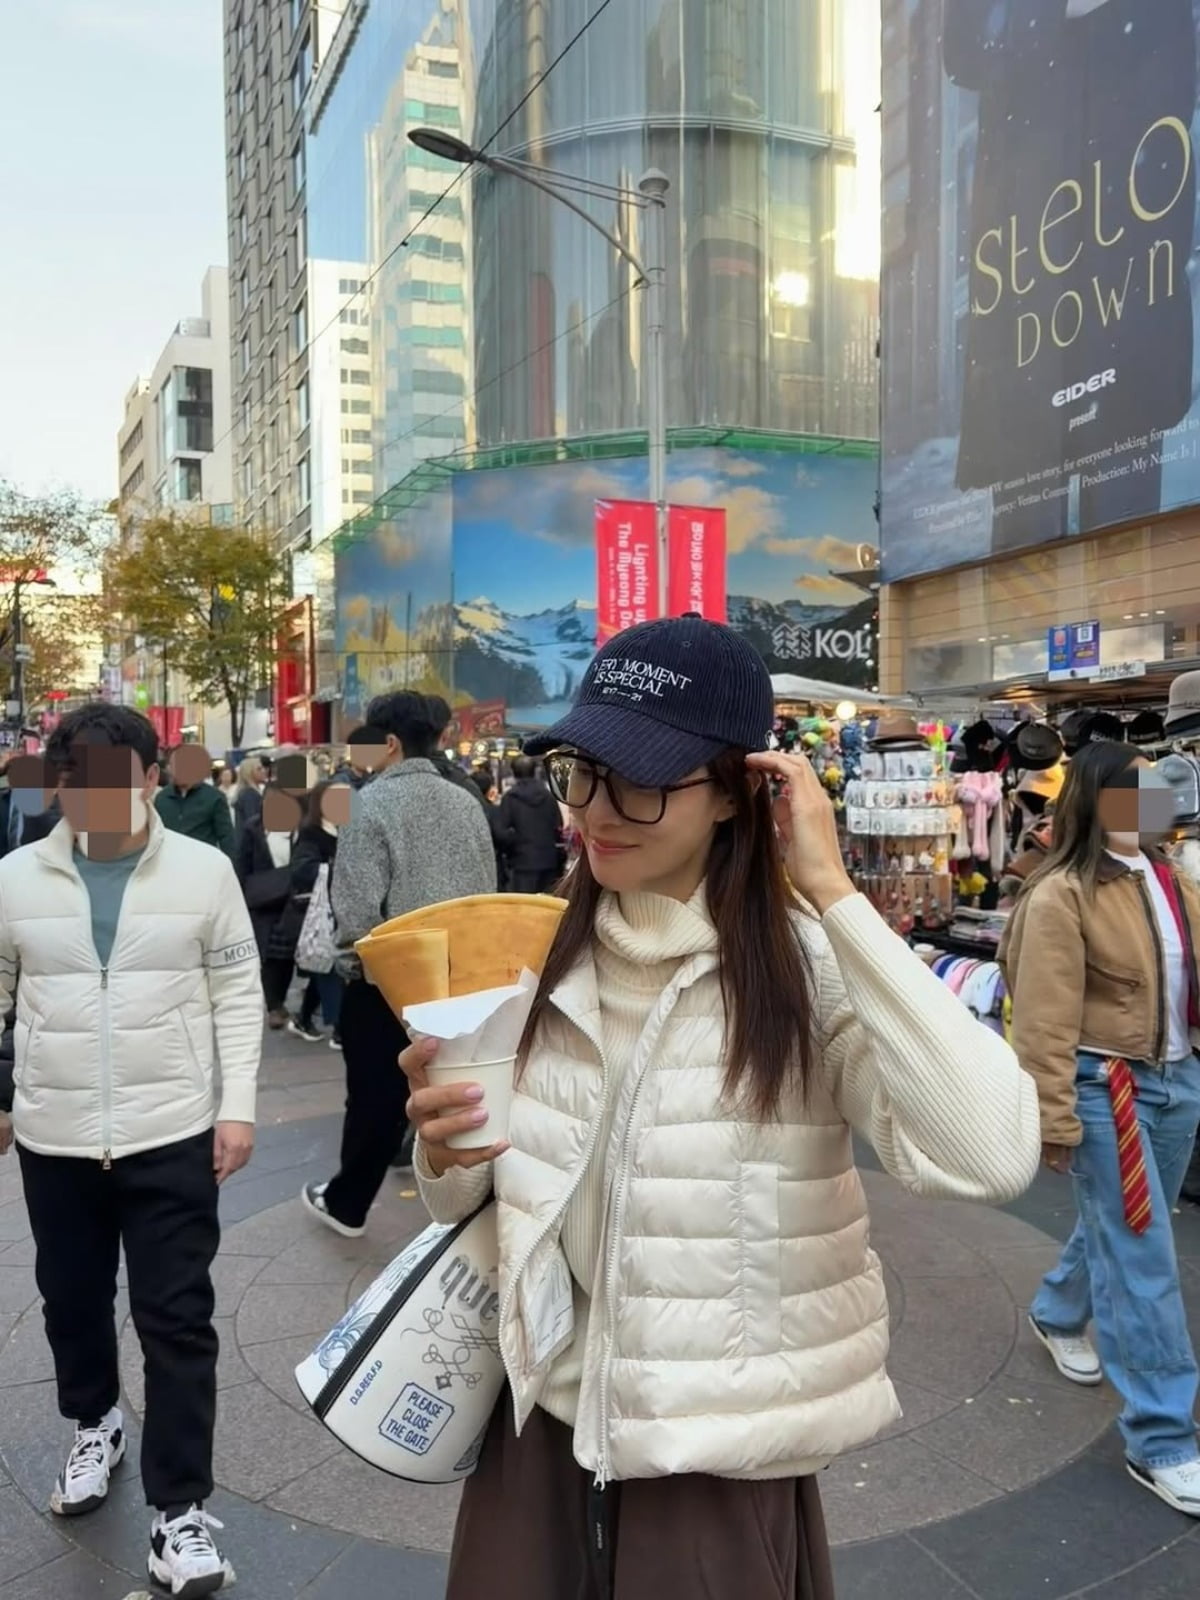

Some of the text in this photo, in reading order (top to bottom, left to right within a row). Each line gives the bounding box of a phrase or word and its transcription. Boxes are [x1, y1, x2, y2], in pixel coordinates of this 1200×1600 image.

[1052, 368, 1116, 407] EIDER
[1063, 459, 1075, 472] for
[1076, 447, 1113, 468] everyone
[1113, 435, 1148, 454] looking
[1150, 417, 1187, 443] forward
[1081, 465, 1131, 489] Production:
[1131, 456, 1149, 473] My
[1149, 451, 1178, 468] Name
[617, 521, 633, 549] The
[616, 550, 633, 608] Myeong
[815, 628, 871, 659] KOL
[604, 670, 664, 697] SPECIAL
[622, 658, 692, 690] MOMENT
[401, 1407, 433, 1433] CLOSE
[407, 1390, 444, 1419] PLEASE
[386, 1418, 430, 1451] THE GATE
